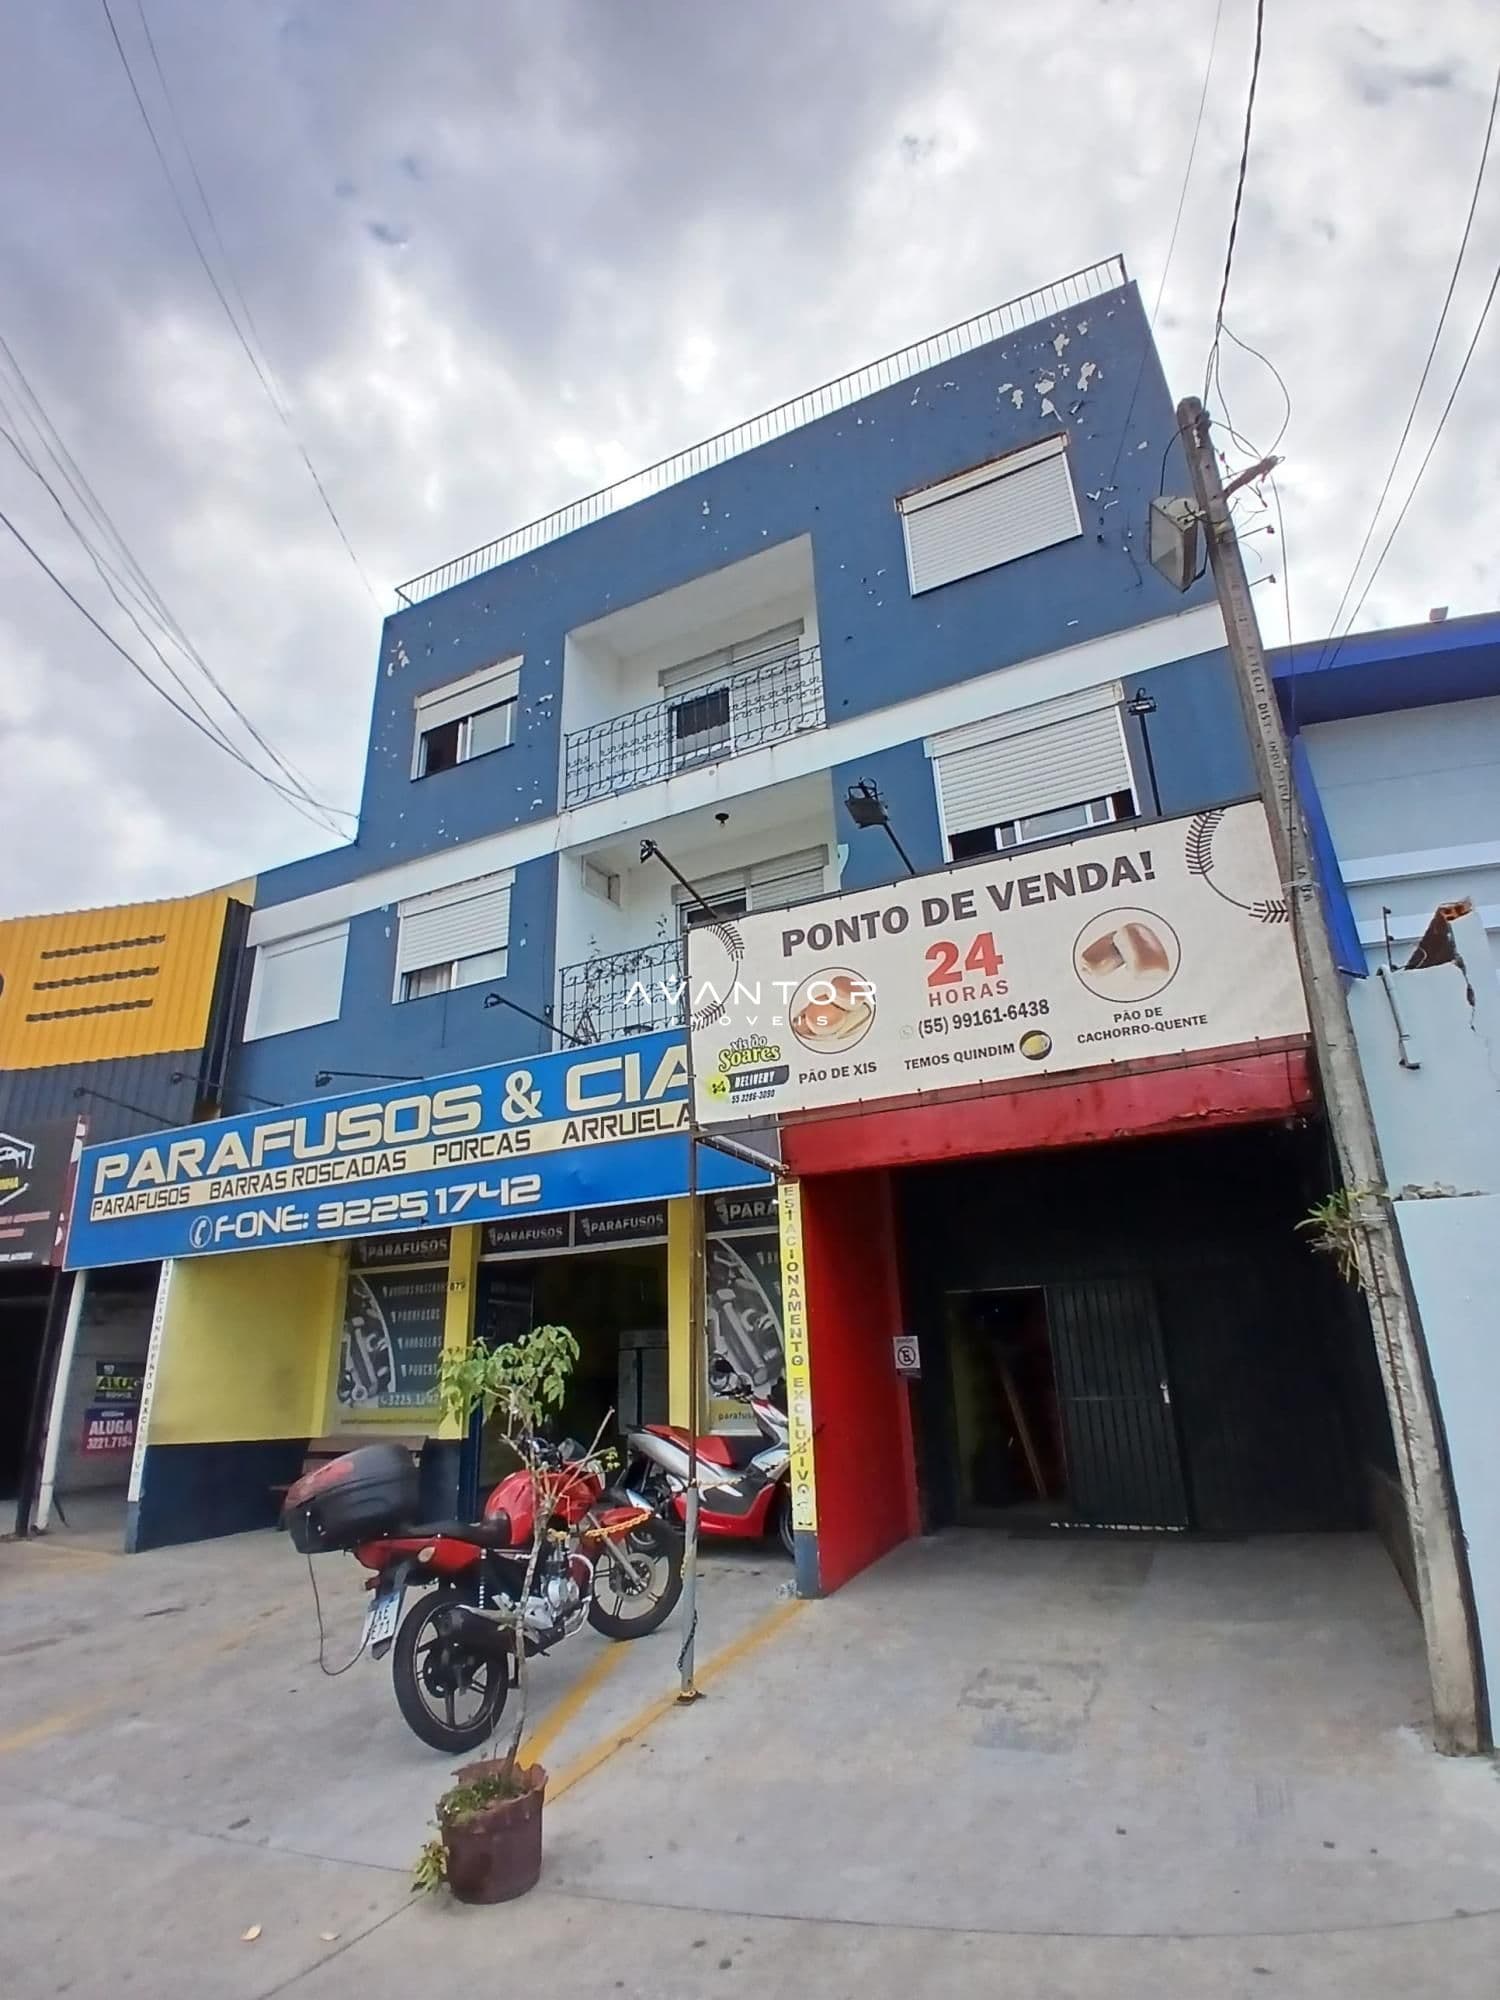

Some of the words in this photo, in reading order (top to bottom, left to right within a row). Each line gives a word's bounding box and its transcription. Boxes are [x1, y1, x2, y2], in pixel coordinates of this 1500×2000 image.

[782, 905, 909, 957] PONTO
[922, 890, 978, 927] DE
[987, 851, 1156, 912] VENDA!
[925, 932, 1004, 987] 24
[928, 980, 1009, 1007] HORAS
[918, 1016, 949, 1039] (55)
[952, 999, 1050, 1030] 99161-6438
[1145, 1006, 1164, 1019] DE
[1077, 1014, 1209, 1044] CACHORRO-QUENTE
[719, 1046, 781, 1072] Soares
[904, 1053, 950, 1070] TEMOS
[954, 1043, 1015, 1063] QUINDIM
[734, 1071, 776, 1088] DELIVERY
[799, 1068, 827, 1084] PÃO
[831, 1065, 850, 1079] DE
[853, 1061, 878, 1076] XIS
[732, 1095, 740, 1104] 55
[94, 1084, 483, 1195] PARAFUSOS
[501, 1070, 543, 1123] &
[92, 1185, 191, 1217] PARAFUSOS
[209, 1170, 287, 1200] BARRAS
[291, 1150, 407, 1188] ROSCADAS
[433, 1129, 532, 1165] PORCAS
[214, 1204, 310, 1243] FONE:
[497, 1227, 564, 1243] PARAFUSOS
[591, 1214, 664, 1233] PARAFUSOS
[367, 1239, 448, 1257] PARAFUSOS
[783, 1186, 804, 1366] ESTACIONAMENTO
[89, 1420, 133, 1436] ALUGA
[793, 1377, 811, 1494] EXCLUSIVO
